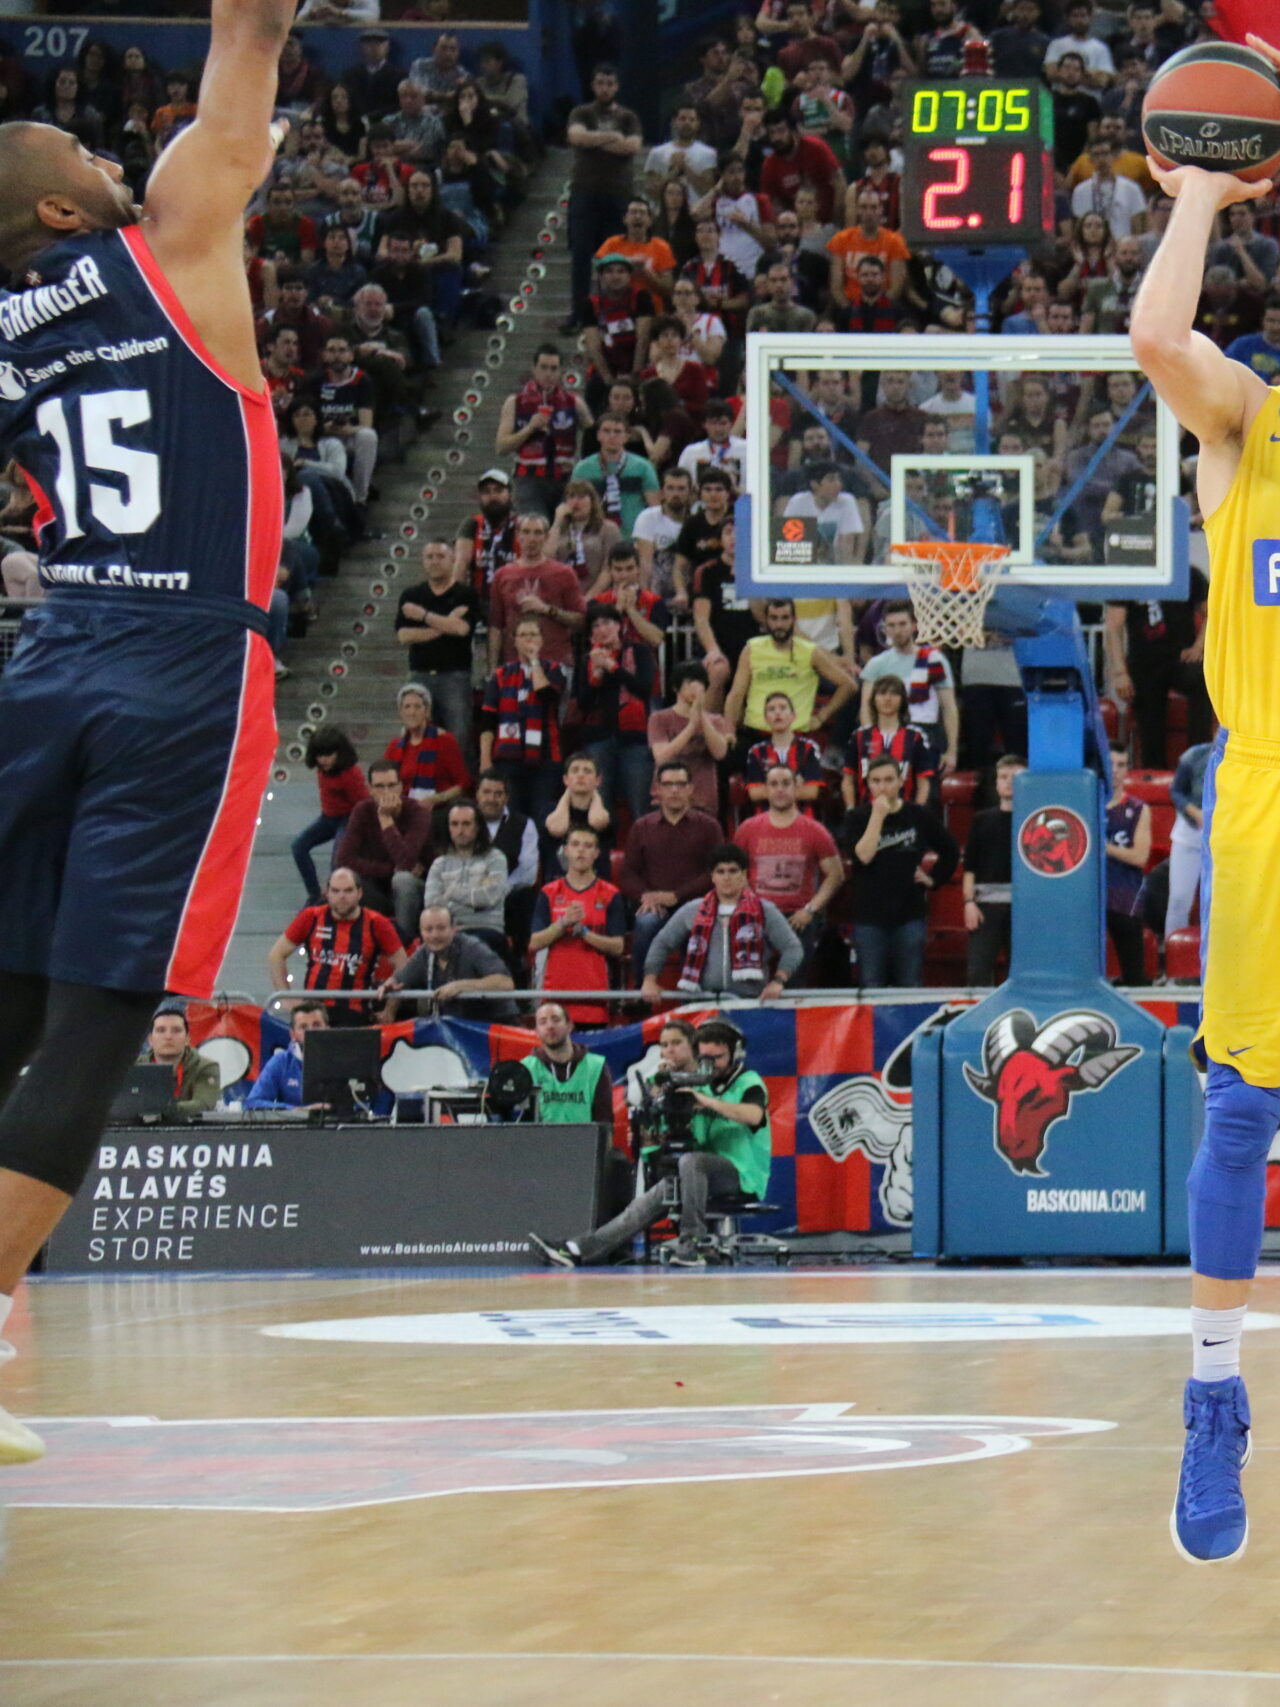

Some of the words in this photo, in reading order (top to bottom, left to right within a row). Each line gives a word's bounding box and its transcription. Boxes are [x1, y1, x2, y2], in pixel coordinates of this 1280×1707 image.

[24, 26, 90, 57] 207
[912, 89, 1030, 132] 07:05
[1159, 125, 1264, 161] SPALDING
[25, 360, 67, 383] Save
[65, 350, 96, 365] the
[96, 336, 169, 361] Children
[36, 389, 162, 539] 15
[98, 1144, 274, 1170] BASKONIA
[93, 1170, 228, 1200] ALAVÉS
[1026, 1189, 1146, 1212] BASKONIA.COM
[91, 1204, 300, 1230] EXPERIENCE
[88, 1236, 195, 1262] STORE
